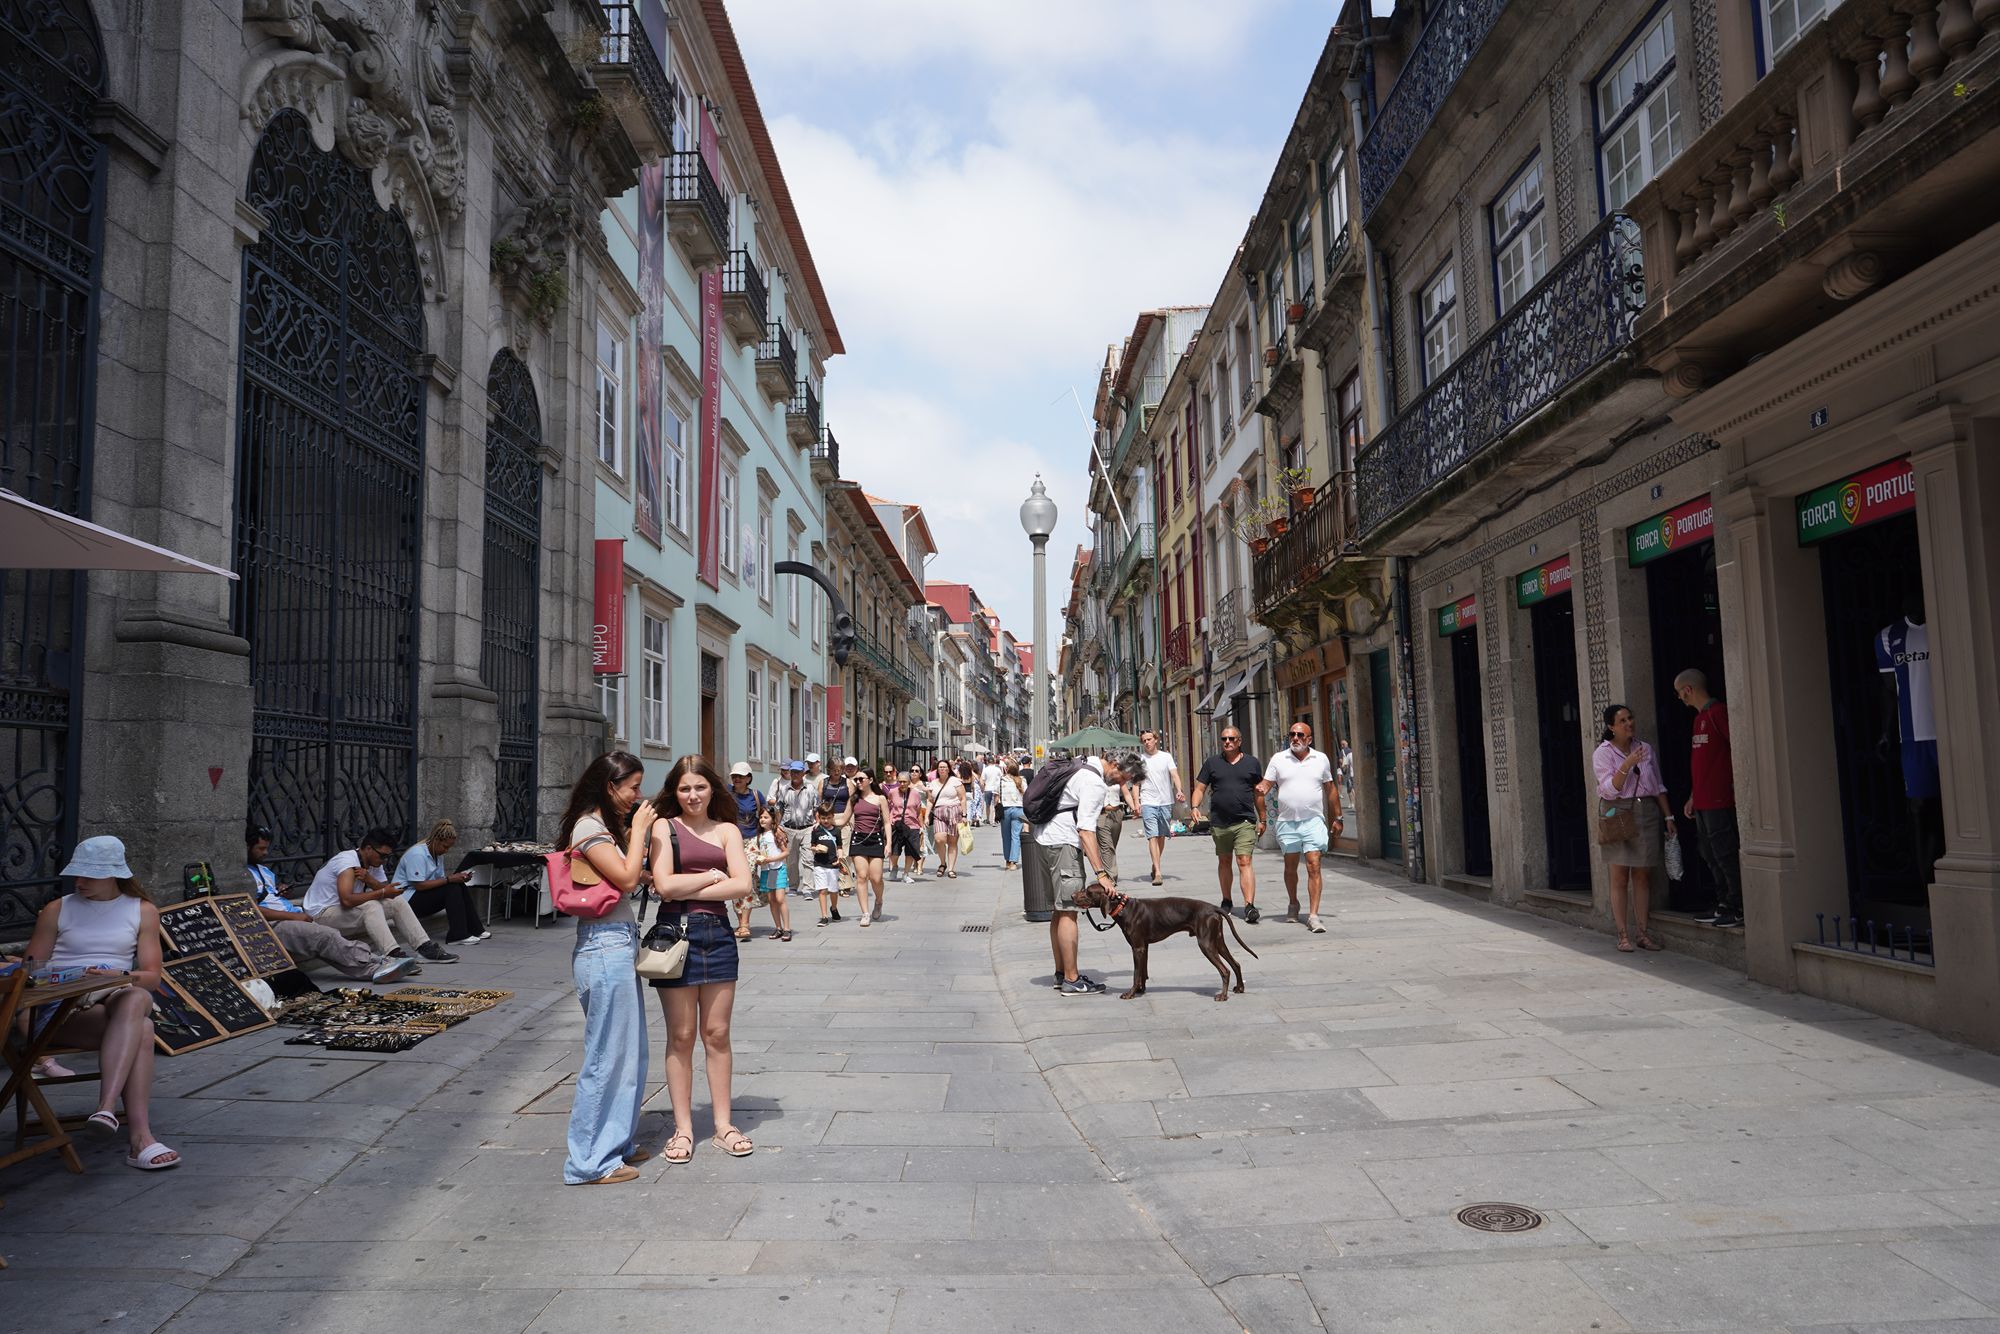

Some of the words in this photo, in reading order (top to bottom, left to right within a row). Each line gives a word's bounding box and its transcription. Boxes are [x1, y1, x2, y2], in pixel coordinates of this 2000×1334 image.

[708, 303, 716, 318] da
[1815, 411, 1822, 426] 6
[1801, 501, 1837, 529] FORÇA
[1635, 529, 1659, 551] FORÇA
